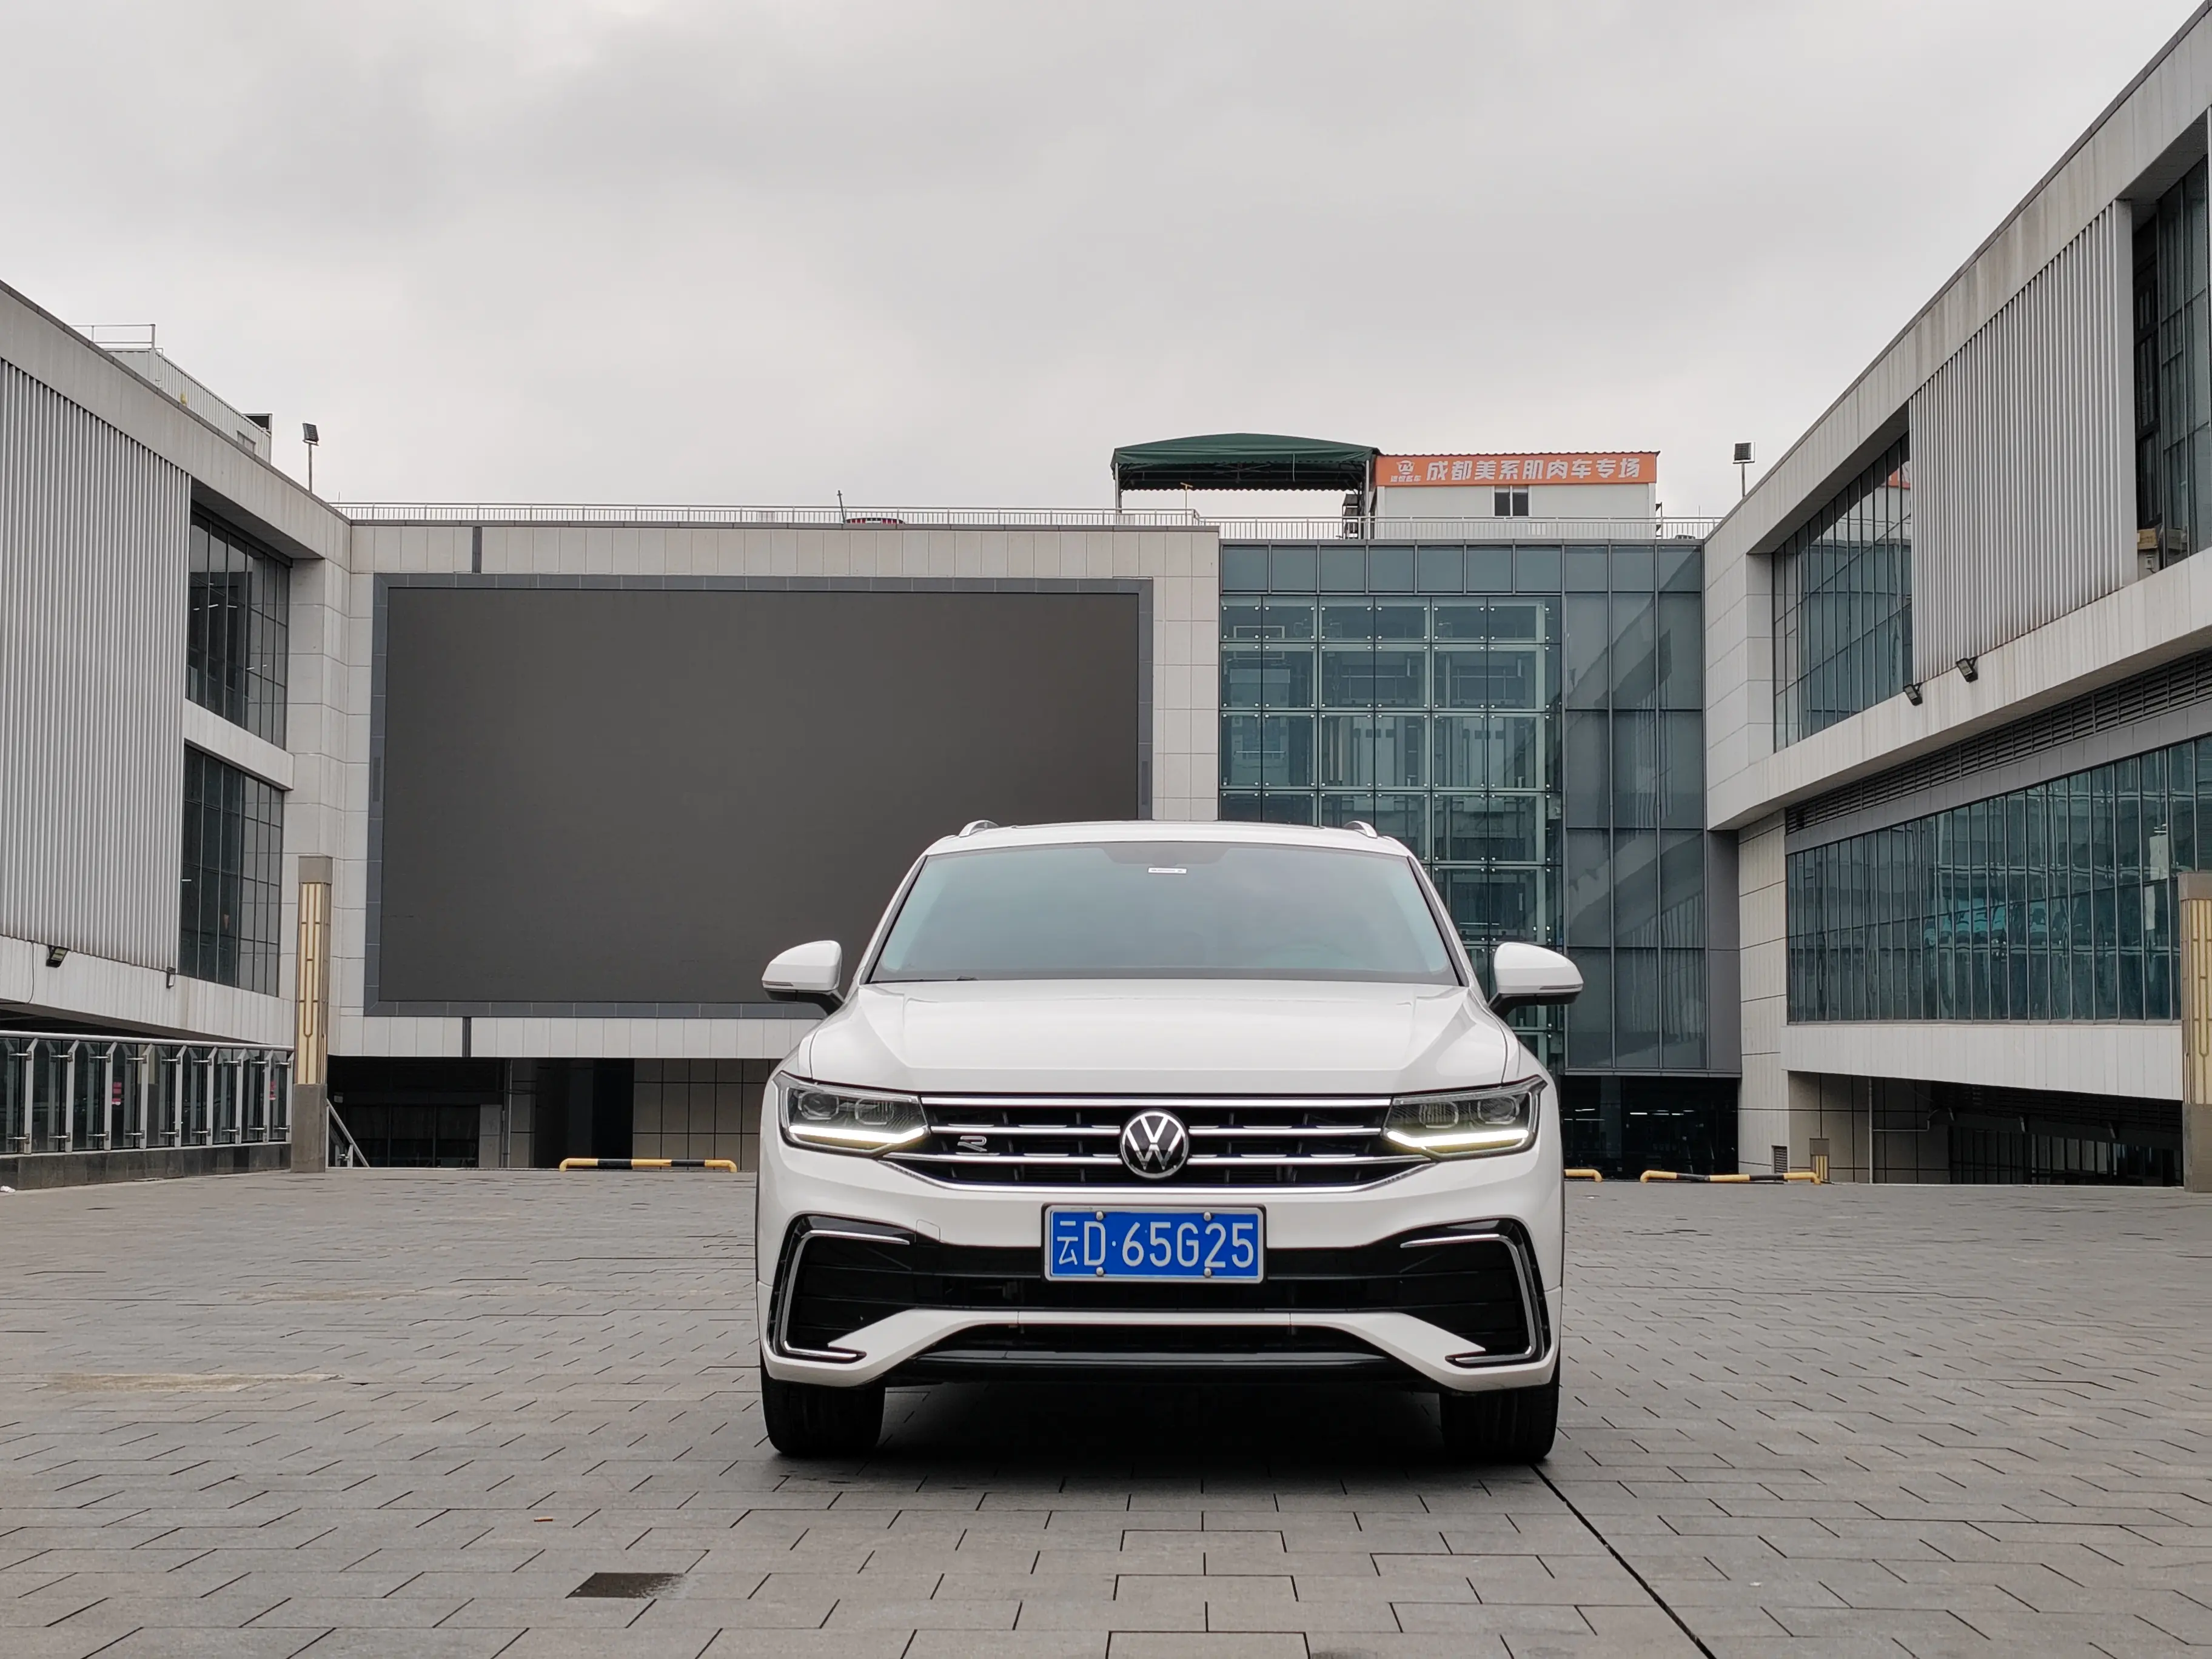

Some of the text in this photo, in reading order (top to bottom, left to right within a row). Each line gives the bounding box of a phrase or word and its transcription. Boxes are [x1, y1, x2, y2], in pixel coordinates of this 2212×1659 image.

[1426, 458, 1640, 481] 成都美系肌肉车专场
